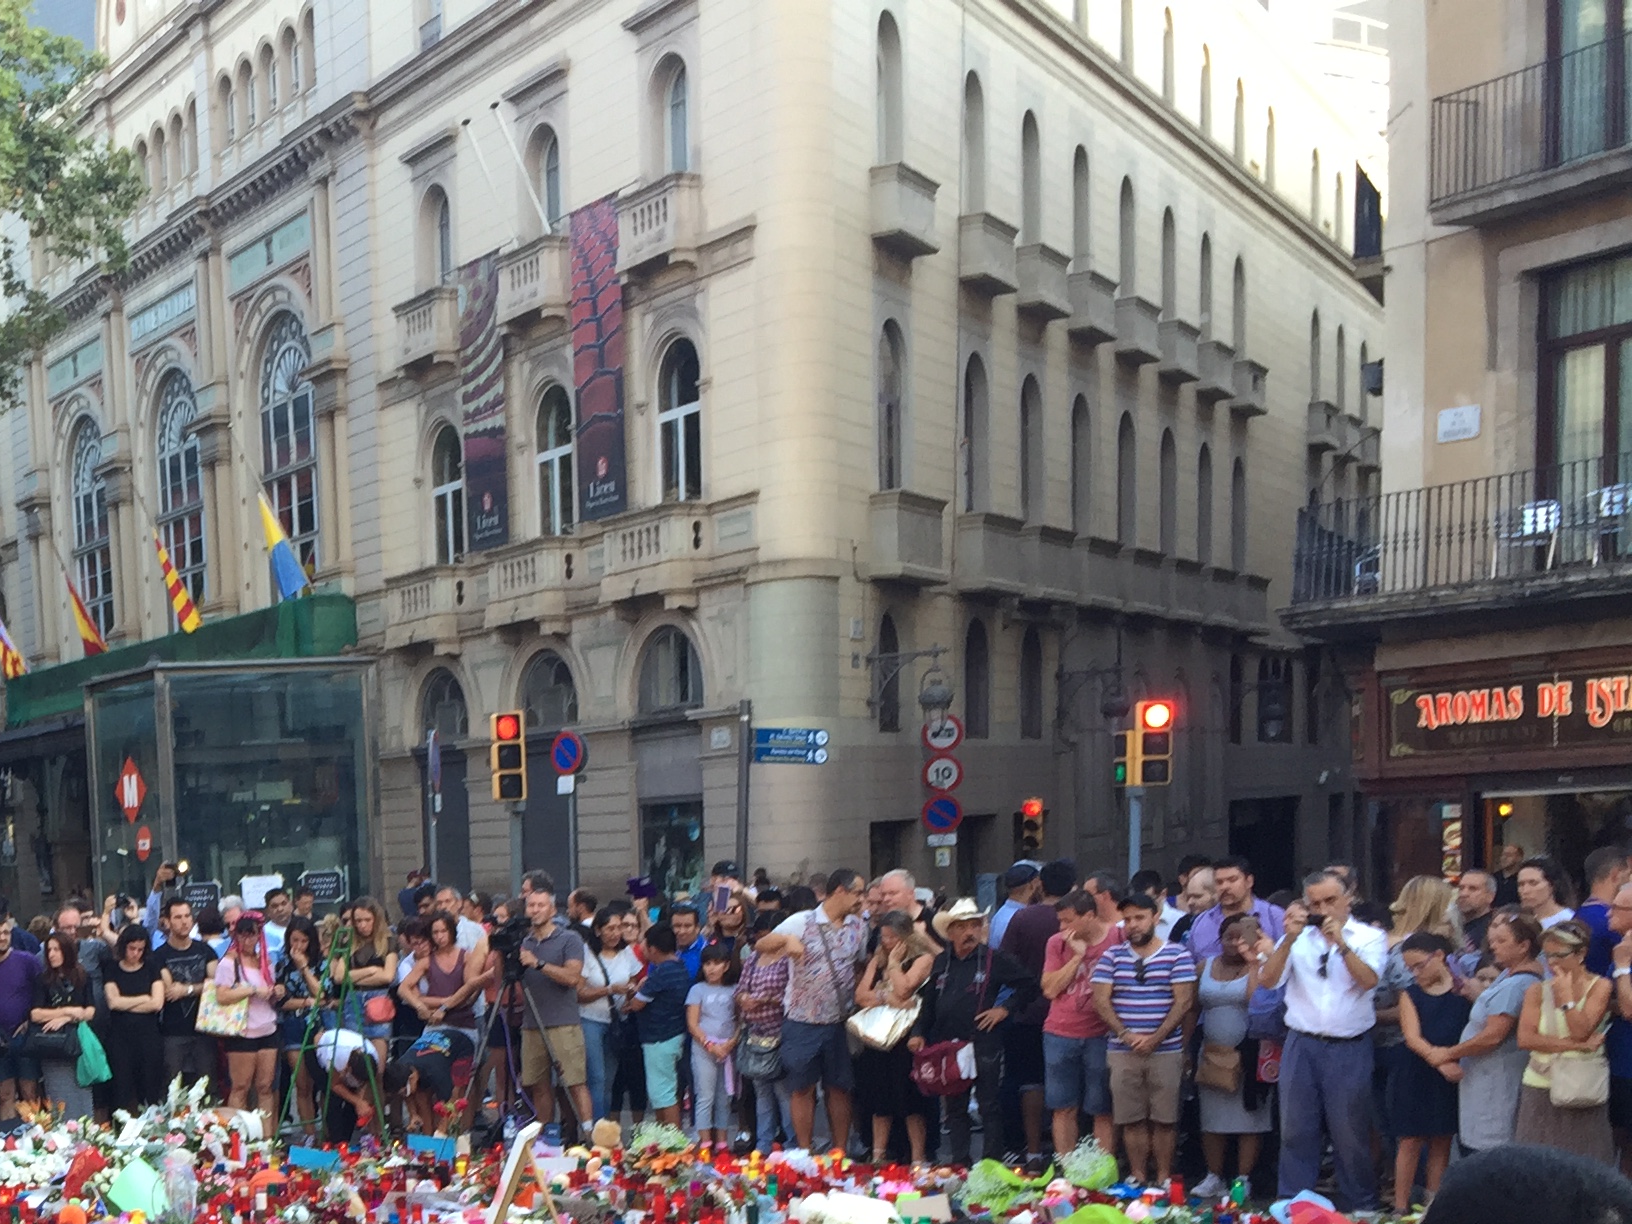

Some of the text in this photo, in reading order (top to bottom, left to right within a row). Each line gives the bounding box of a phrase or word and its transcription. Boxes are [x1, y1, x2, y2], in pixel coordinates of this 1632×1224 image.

[1415, 685, 1524, 731] AROMAS
[1536, 680, 1573, 718] DE
[1585, 675, 1632, 728] IST
[123, 773, 139, 809] M
[934, 766, 953, 781] 10
